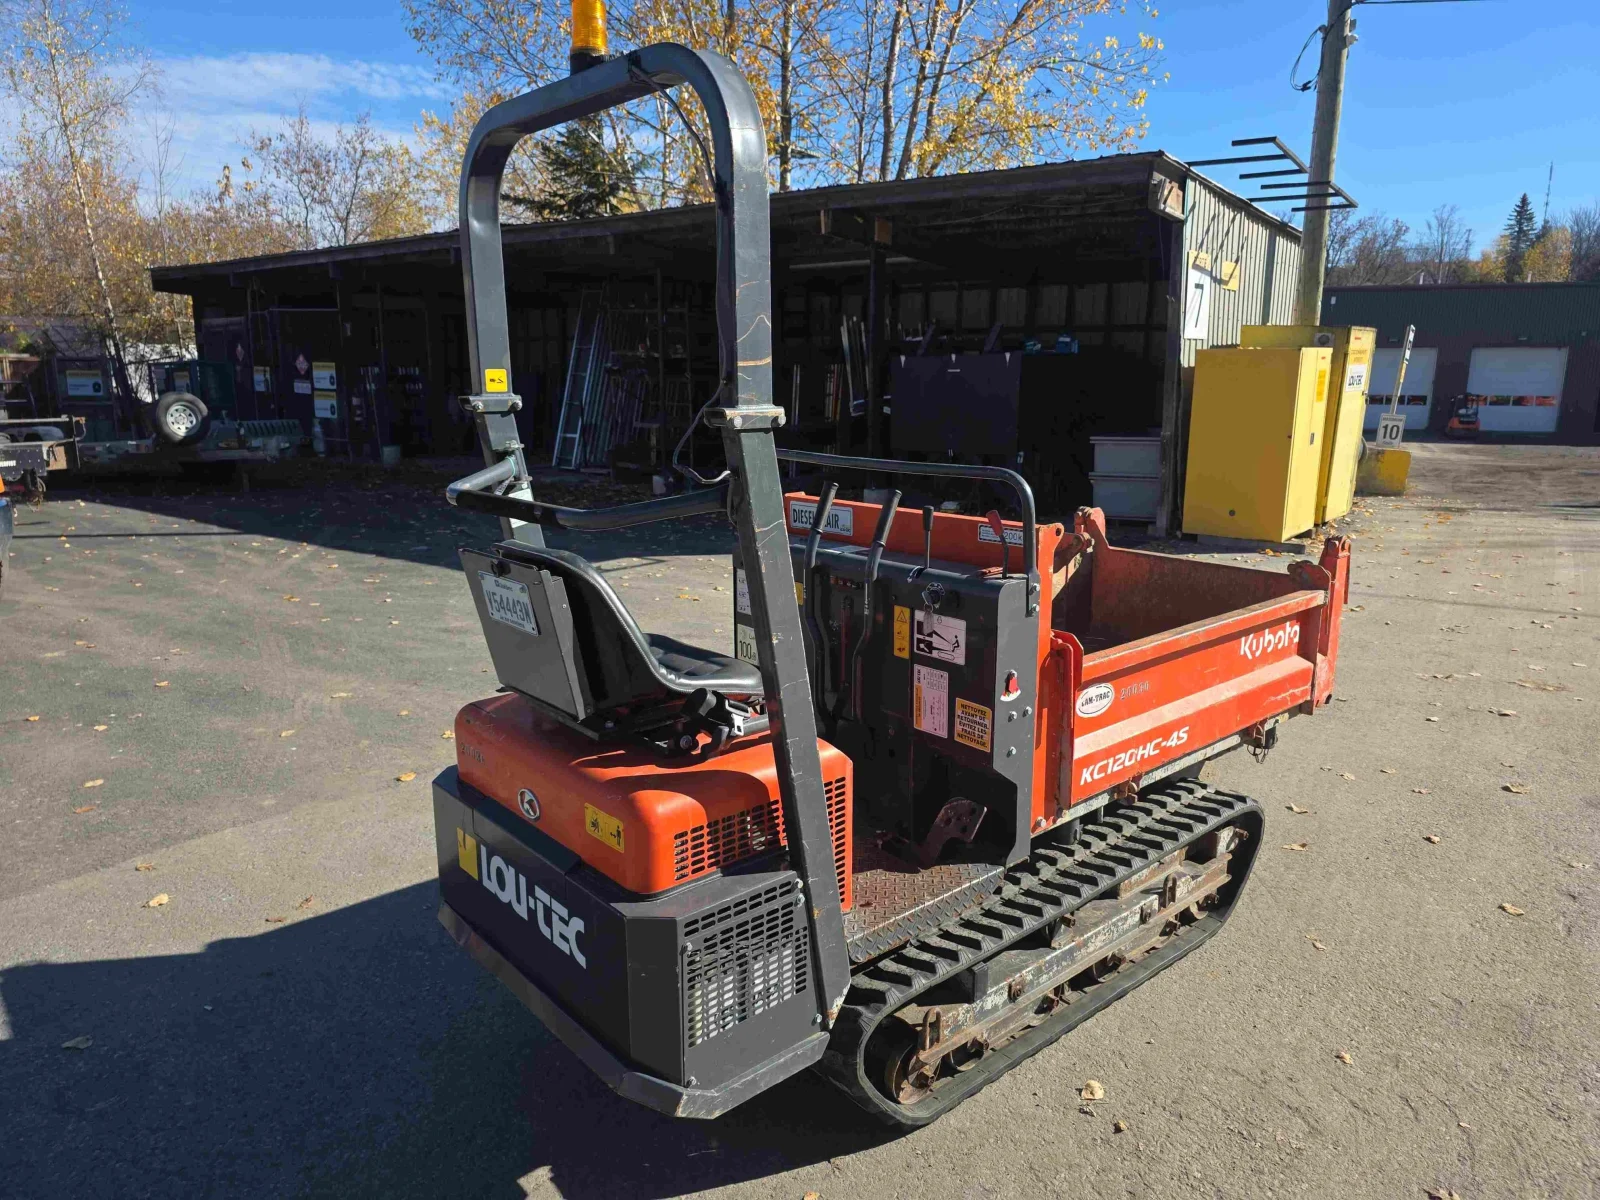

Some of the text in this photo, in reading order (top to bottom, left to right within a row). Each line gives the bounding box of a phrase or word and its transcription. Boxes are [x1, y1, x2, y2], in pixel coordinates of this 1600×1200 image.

[1194, 283, 1204, 328] 7
[1382, 424, 1400, 440] 10
[1240, 620, 1300, 660] Kubota
[961, 703, 986, 716] NETTOYEZ
[962, 728, 976, 737] FRAIS
[1080, 726, 1190, 786] KC120HC-4S
[480, 844, 587, 970] LOU-TEC
